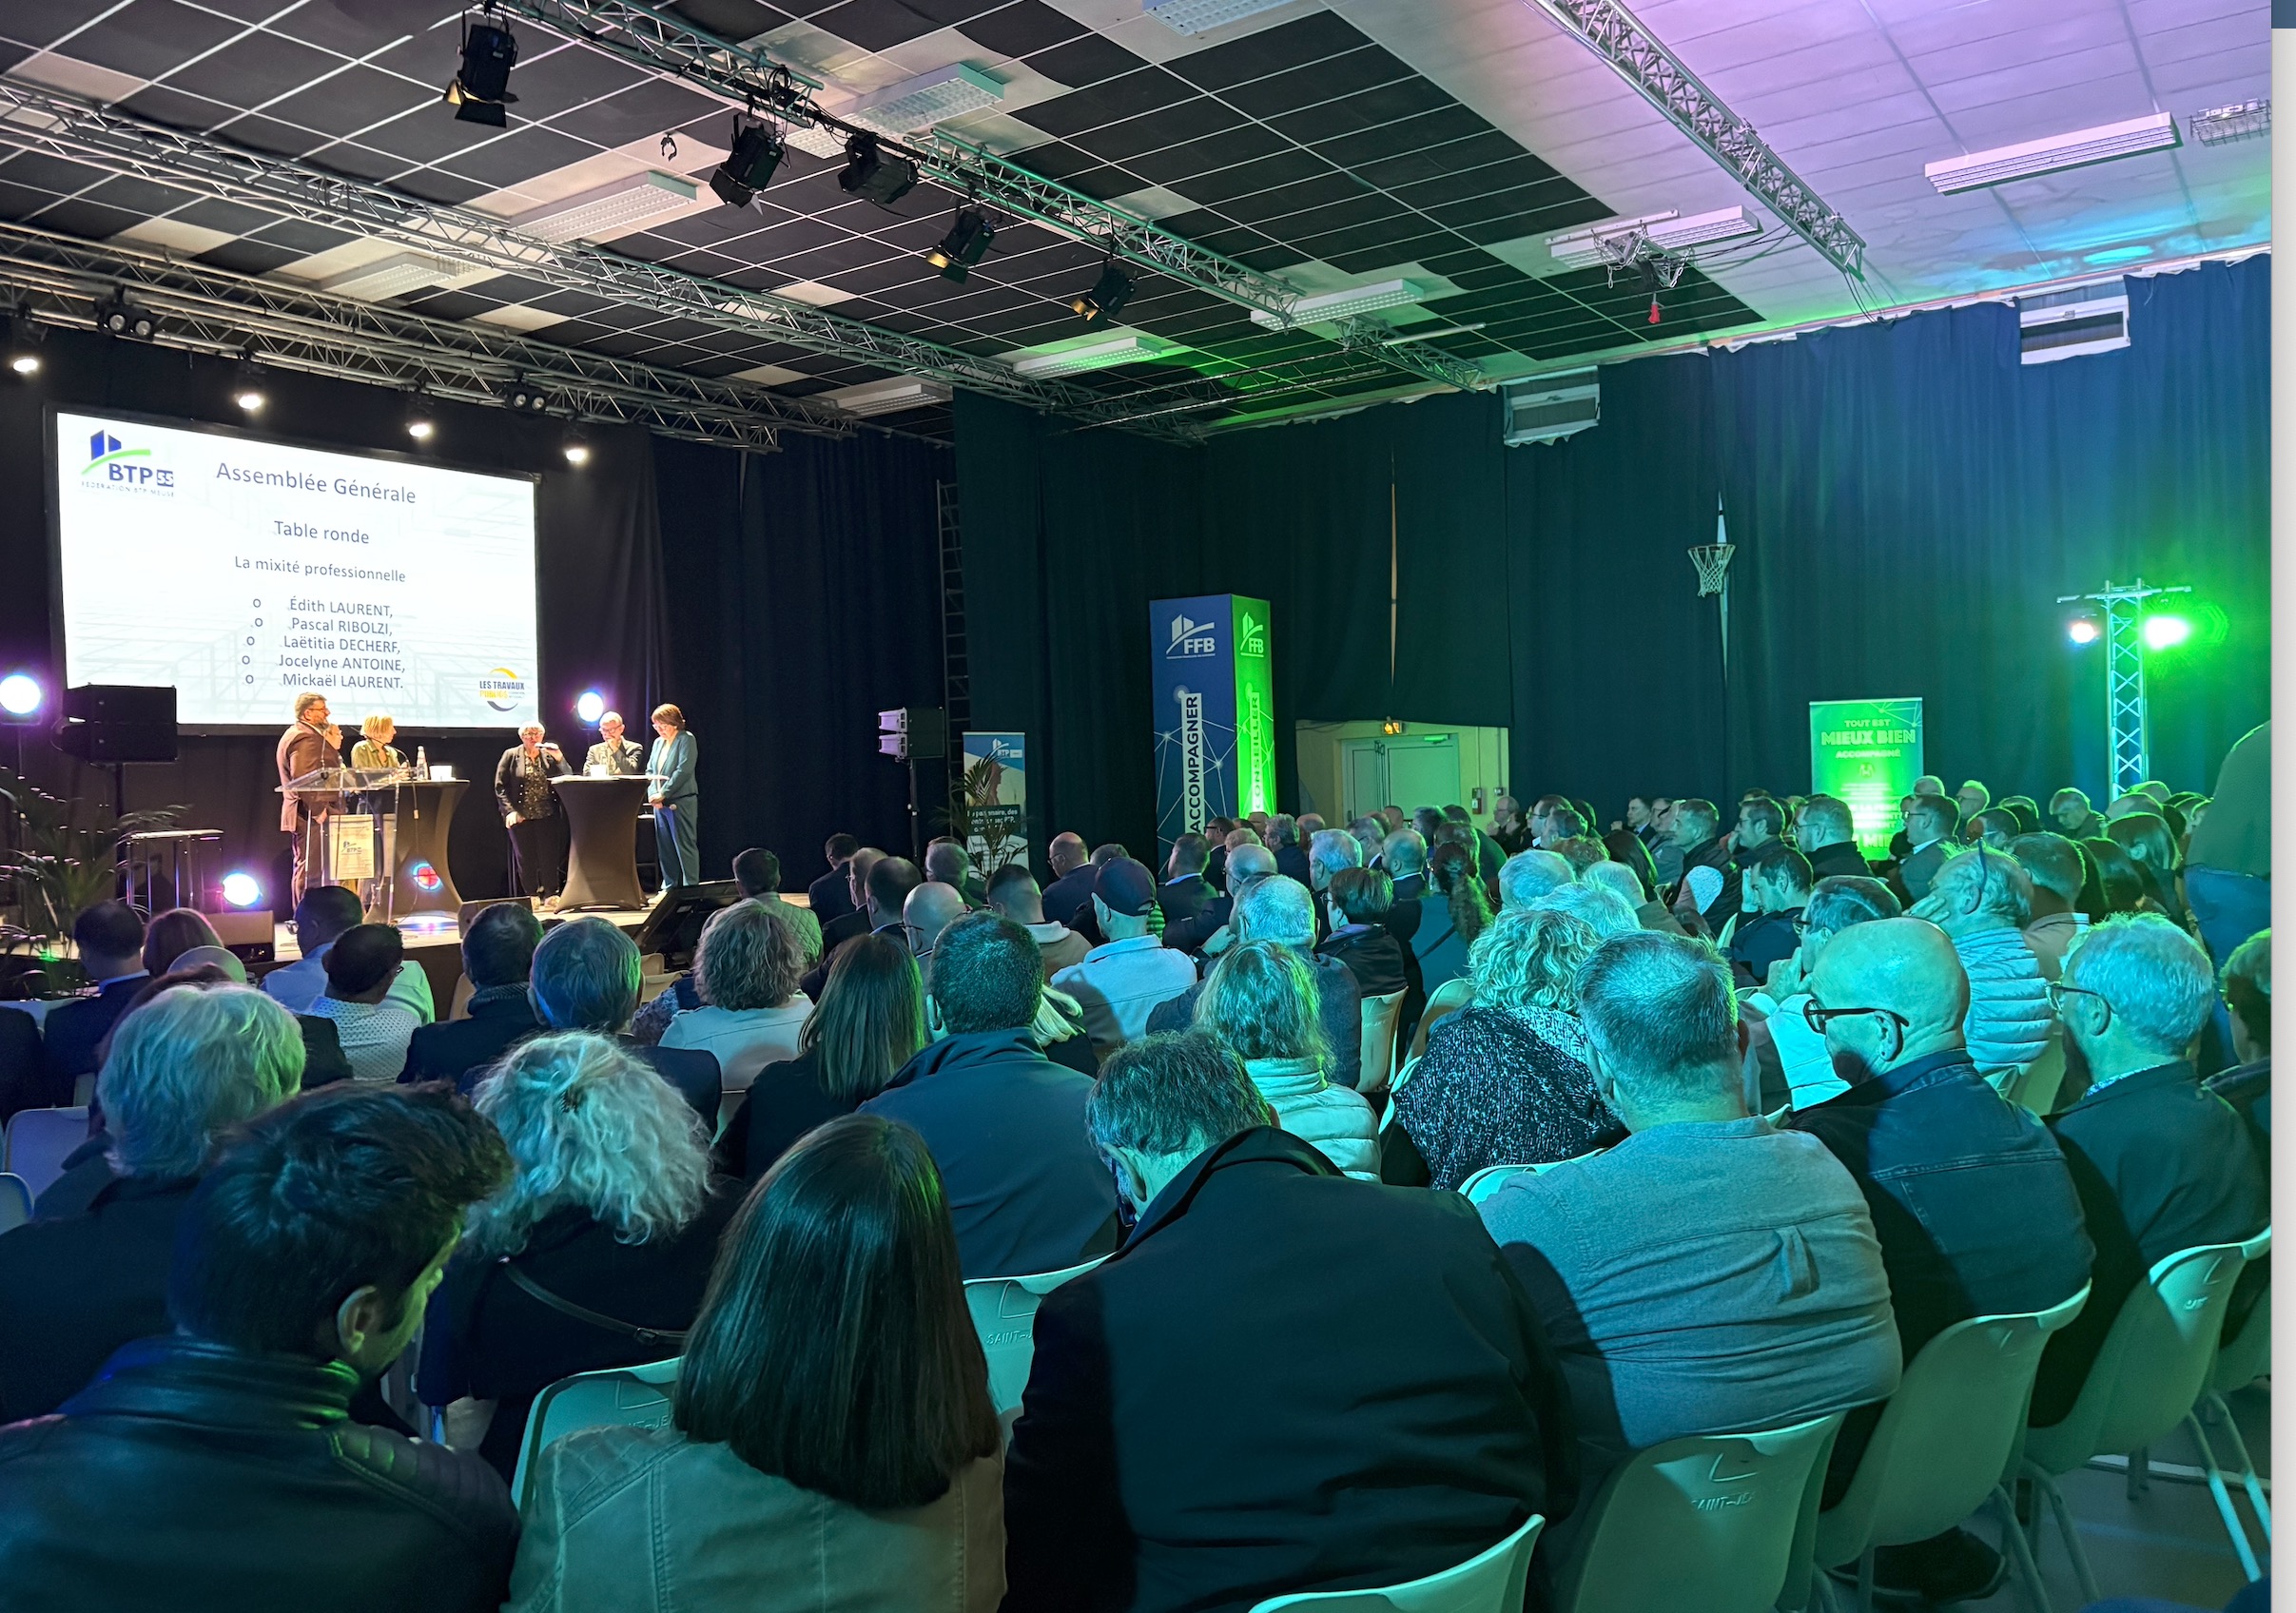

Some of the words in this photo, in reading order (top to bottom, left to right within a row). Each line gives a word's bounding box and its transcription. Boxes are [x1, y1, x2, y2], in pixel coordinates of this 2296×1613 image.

[108, 463, 153, 484] BTP
[217, 462, 327, 492] Assemblée
[334, 478, 416, 503] Générale
[274, 520, 318, 538] Table
[323, 529, 369, 544] ronde
[235, 555, 250, 569] La
[256, 558, 300, 573] mixité
[304, 563, 406, 582] professionnelle
[290, 595, 325, 612] Édith
[330, 601, 393, 618] LAURENT,
[292, 617, 334, 632] Pascal
[339, 620, 393, 636] RIBOLZI,
[283, 635, 335, 651] Laëtitia
[340, 638, 400, 654] DECHERF,
[1184, 637, 1216, 654] FFB
[1249, 638, 1263, 653] FFB
[279, 654, 338, 670] Jocelyne
[342, 657, 405, 673] ANTOINE,
[282, 673, 336, 688] Mickaël
[341, 676, 403, 690] LAURENT.
[479, 681, 491, 690] LES
[494, 681, 525, 690] TRAVAUX
[1844, 719, 1871, 728] TOUT
[1872, 718, 1892, 728] EST
[1820, 729, 1875, 746] MIEUX
[1877, 729, 1917, 745] BIEN
[1186, 696, 1202, 834] ACCOMPAGNER
